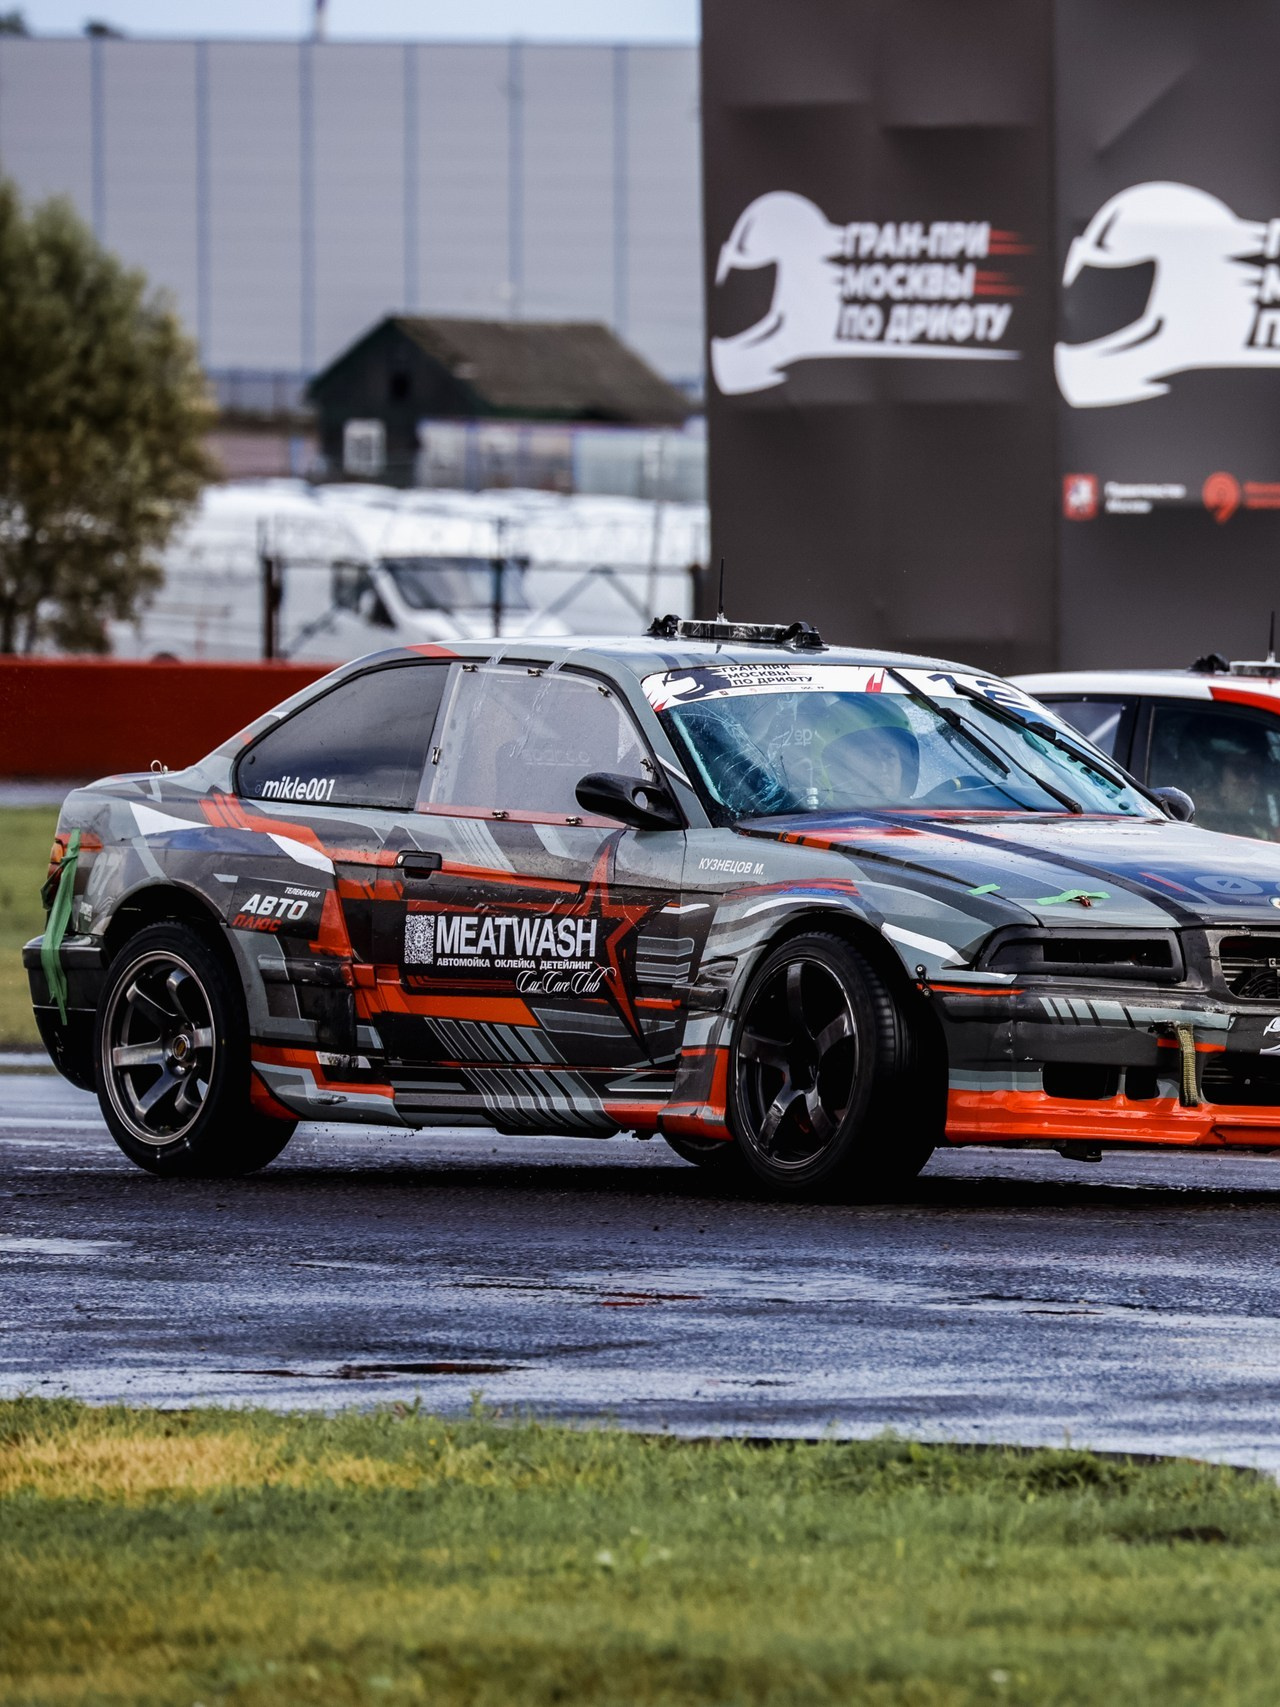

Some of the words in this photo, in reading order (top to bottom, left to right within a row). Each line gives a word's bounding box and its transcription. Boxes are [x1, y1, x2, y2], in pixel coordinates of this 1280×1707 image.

[844, 221, 991, 258] ГРАН-ПРИ
[842, 262, 976, 299] МОСКВЫ
[841, 303, 884, 339] ПО
[885, 303, 1013, 342] ДРИФТУ
[721, 665, 791, 673] ГРАН-ПРИ
[727, 670, 791, 679] МОСКВЫ
[757, 676, 813, 684] ДРИФТУ
[261, 776, 336, 801] mikle001
[698, 858, 753, 875] КУЗНЕЦОВ
[753, 863, 765, 875] М.
[284, 886, 321, 899] ТЕЛЕКАНАЛ
[240, 893, 309, 920] АВТО
[232, 913, 283, 933] ПЛЮС
[436, 916, 598, 958] MEATWASH
[436, 957, 491, 968] АВТОМОЙКА
[494, 957, 536, 969] ОКЛЕЙКА
[539, 959, 593, 971] ДЕТЕЙЛИНГ
[516, 970, 542, 993] Car
[542, 971, 570, 994] Care
[571, 967, 617, 995] Club
